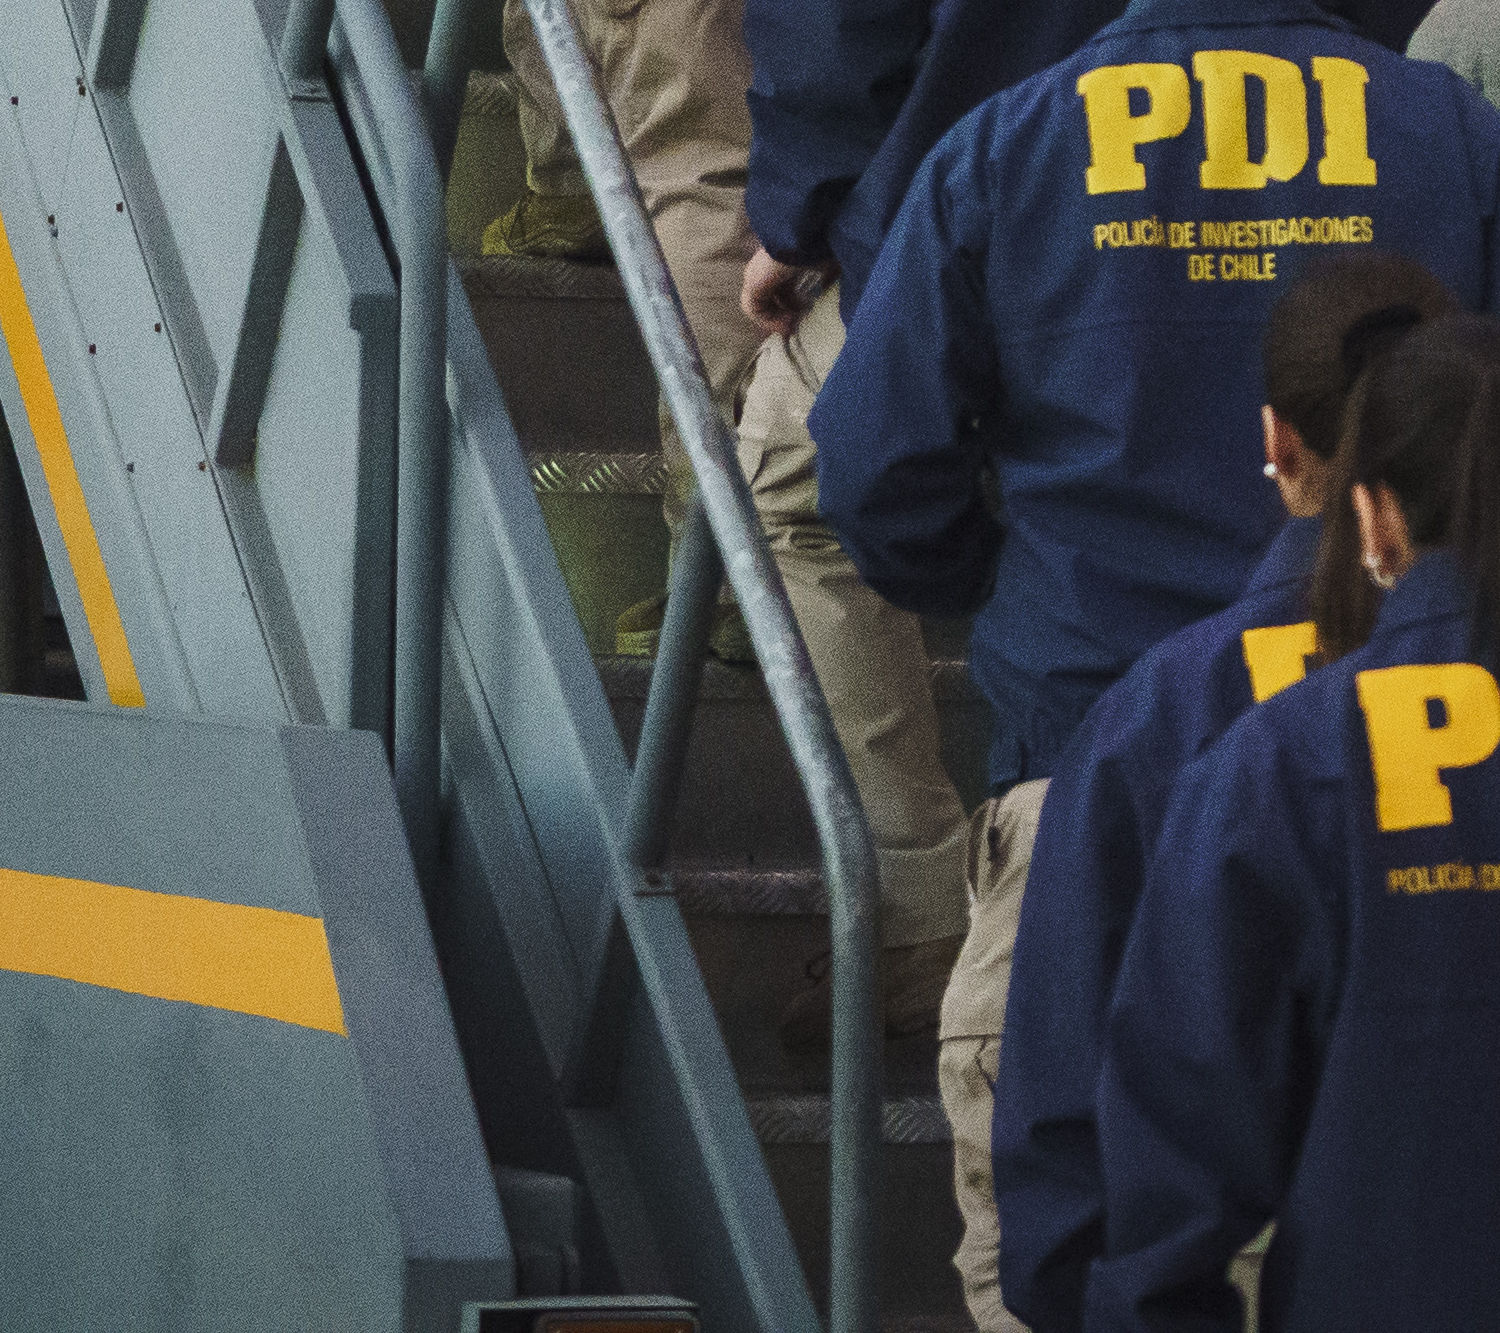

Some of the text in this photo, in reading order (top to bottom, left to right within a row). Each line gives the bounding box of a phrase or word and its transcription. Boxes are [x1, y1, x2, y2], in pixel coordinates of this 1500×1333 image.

[1077, 49, 1377, 195] PDI
[1167, 221, 1197, 250] DE
[1199, 215, 1373, 250] INVESTIGACIONES
[1188, 252, 1277, 281] DE CHILE
